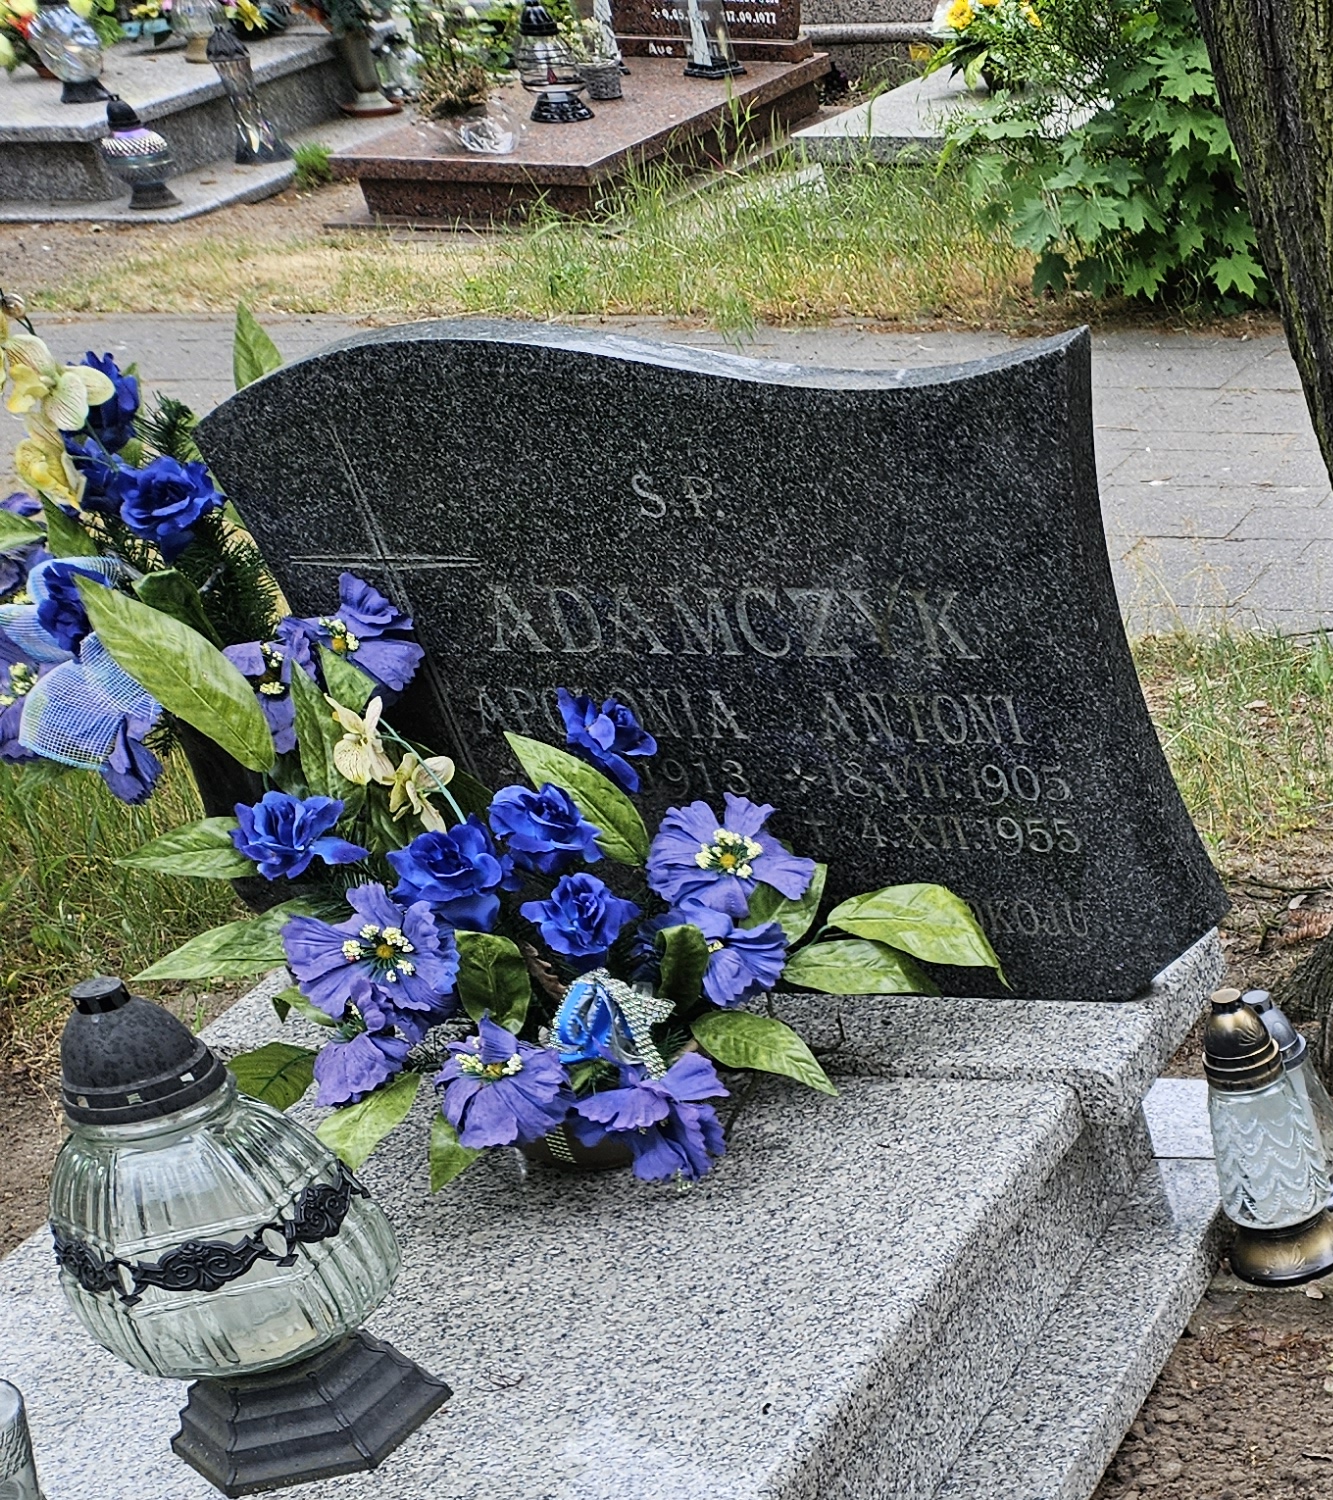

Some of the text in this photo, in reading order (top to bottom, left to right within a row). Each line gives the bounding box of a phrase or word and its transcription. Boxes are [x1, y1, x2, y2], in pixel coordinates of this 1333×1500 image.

[725, 10, 777, 25] 17.09.1977
[648, 42, 673, 55] Ave
[488, 583, 981, 660] ADAMCZYK
[820, 691, 1026, 746] ANTONI
